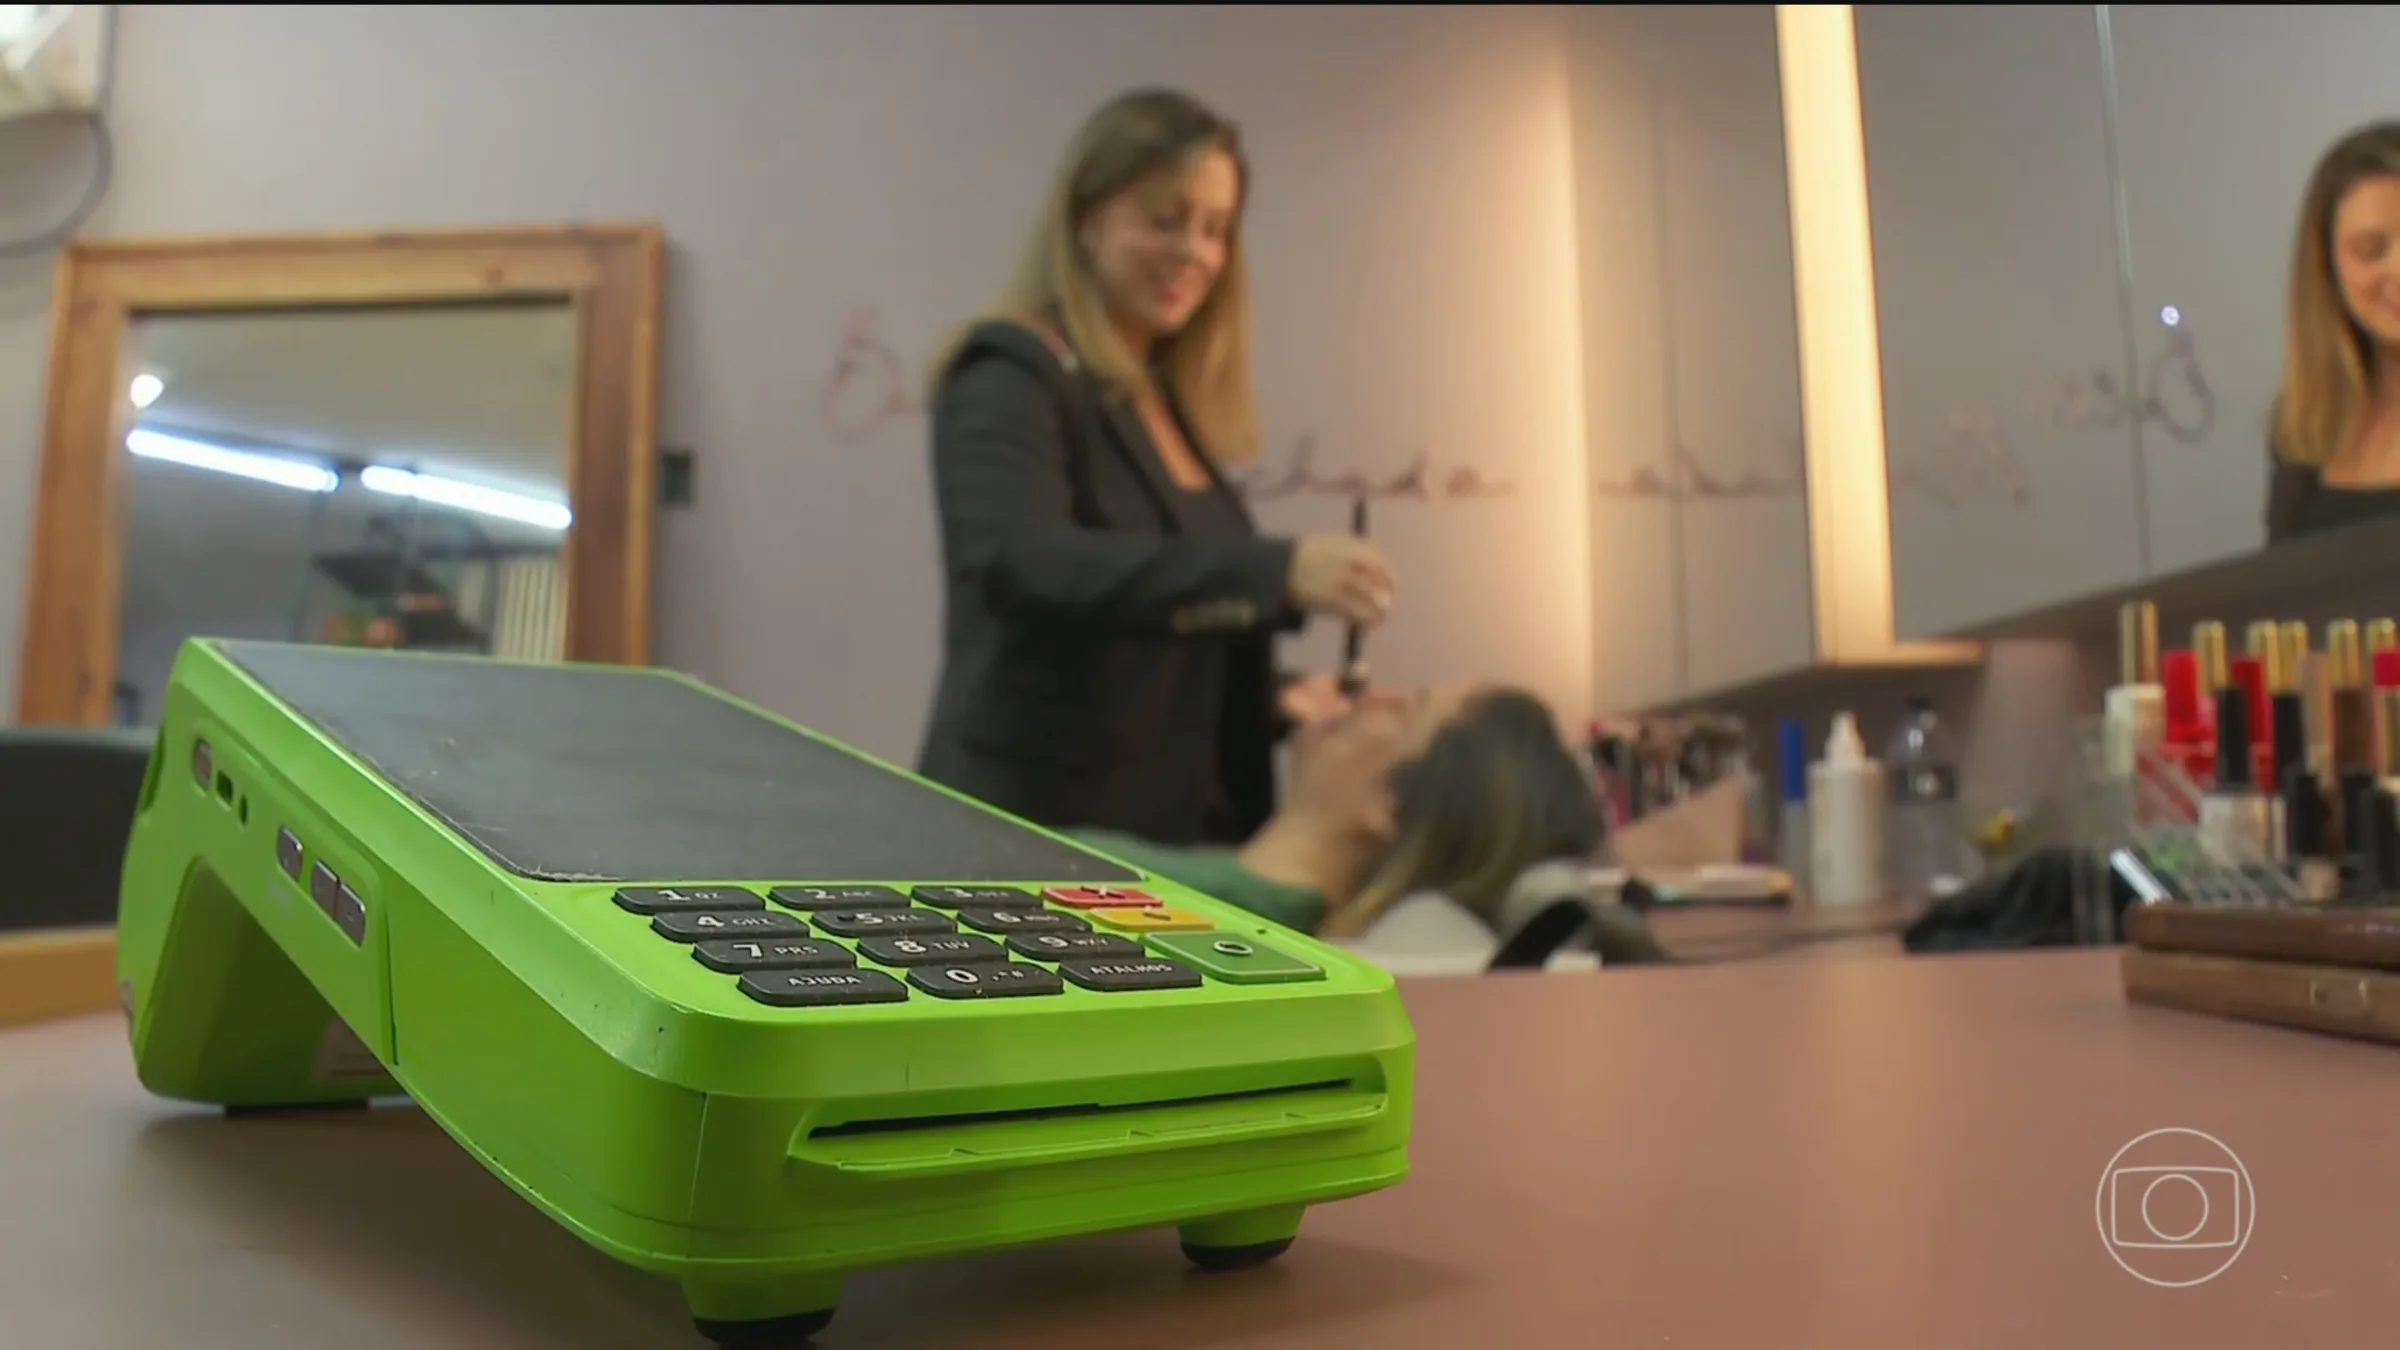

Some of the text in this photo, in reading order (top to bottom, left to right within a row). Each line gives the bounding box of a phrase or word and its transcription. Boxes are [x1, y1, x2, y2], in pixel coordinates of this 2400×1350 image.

[657, 889, 691, 901] 1
[804, 888, 836, 900] 2
[944, 887, 974, 898] 3
[697, 915, 725, 928] 4
[855, 912, 884, 925] 5
[993, 912, 1022, 924] 6
[894, 939, 927, 953] 8
[1038, 935, 1069, 949] 9
[733, 943, 763, 958] 7
[945, 968, 980, 984] 0
[1089, 963, 1174, 976] ATALHOS
[788, 975, 863, 986] AJUDA
